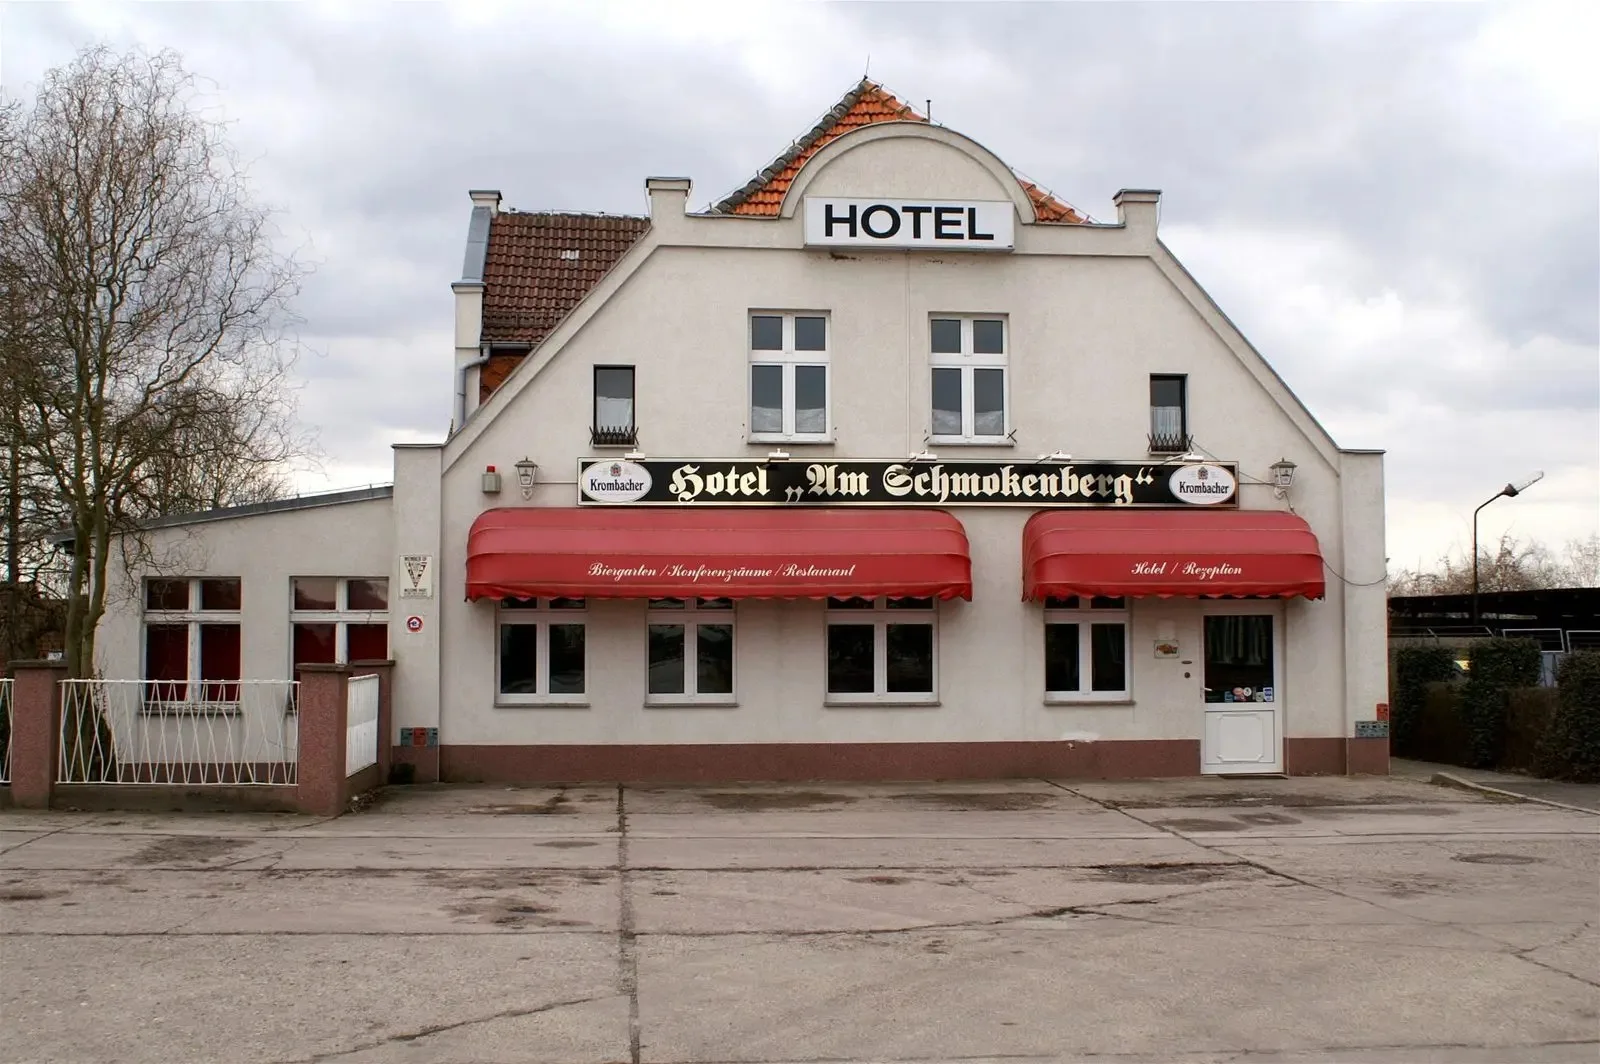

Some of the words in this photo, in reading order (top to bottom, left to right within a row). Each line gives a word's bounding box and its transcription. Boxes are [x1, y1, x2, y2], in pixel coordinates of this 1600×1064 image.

[825, 204, 994, 240] HOTEL
[590, 478, 644, 491] Krombacher
[669, 463, 770, 504] Hotel
[1179, 481, 1229, 494] Krombacher
[588, 562, 656, 581] Biergarten
[1131, 561, 1166, 575] Hotel
[1182, 561, 1242, 580] Rezeption
